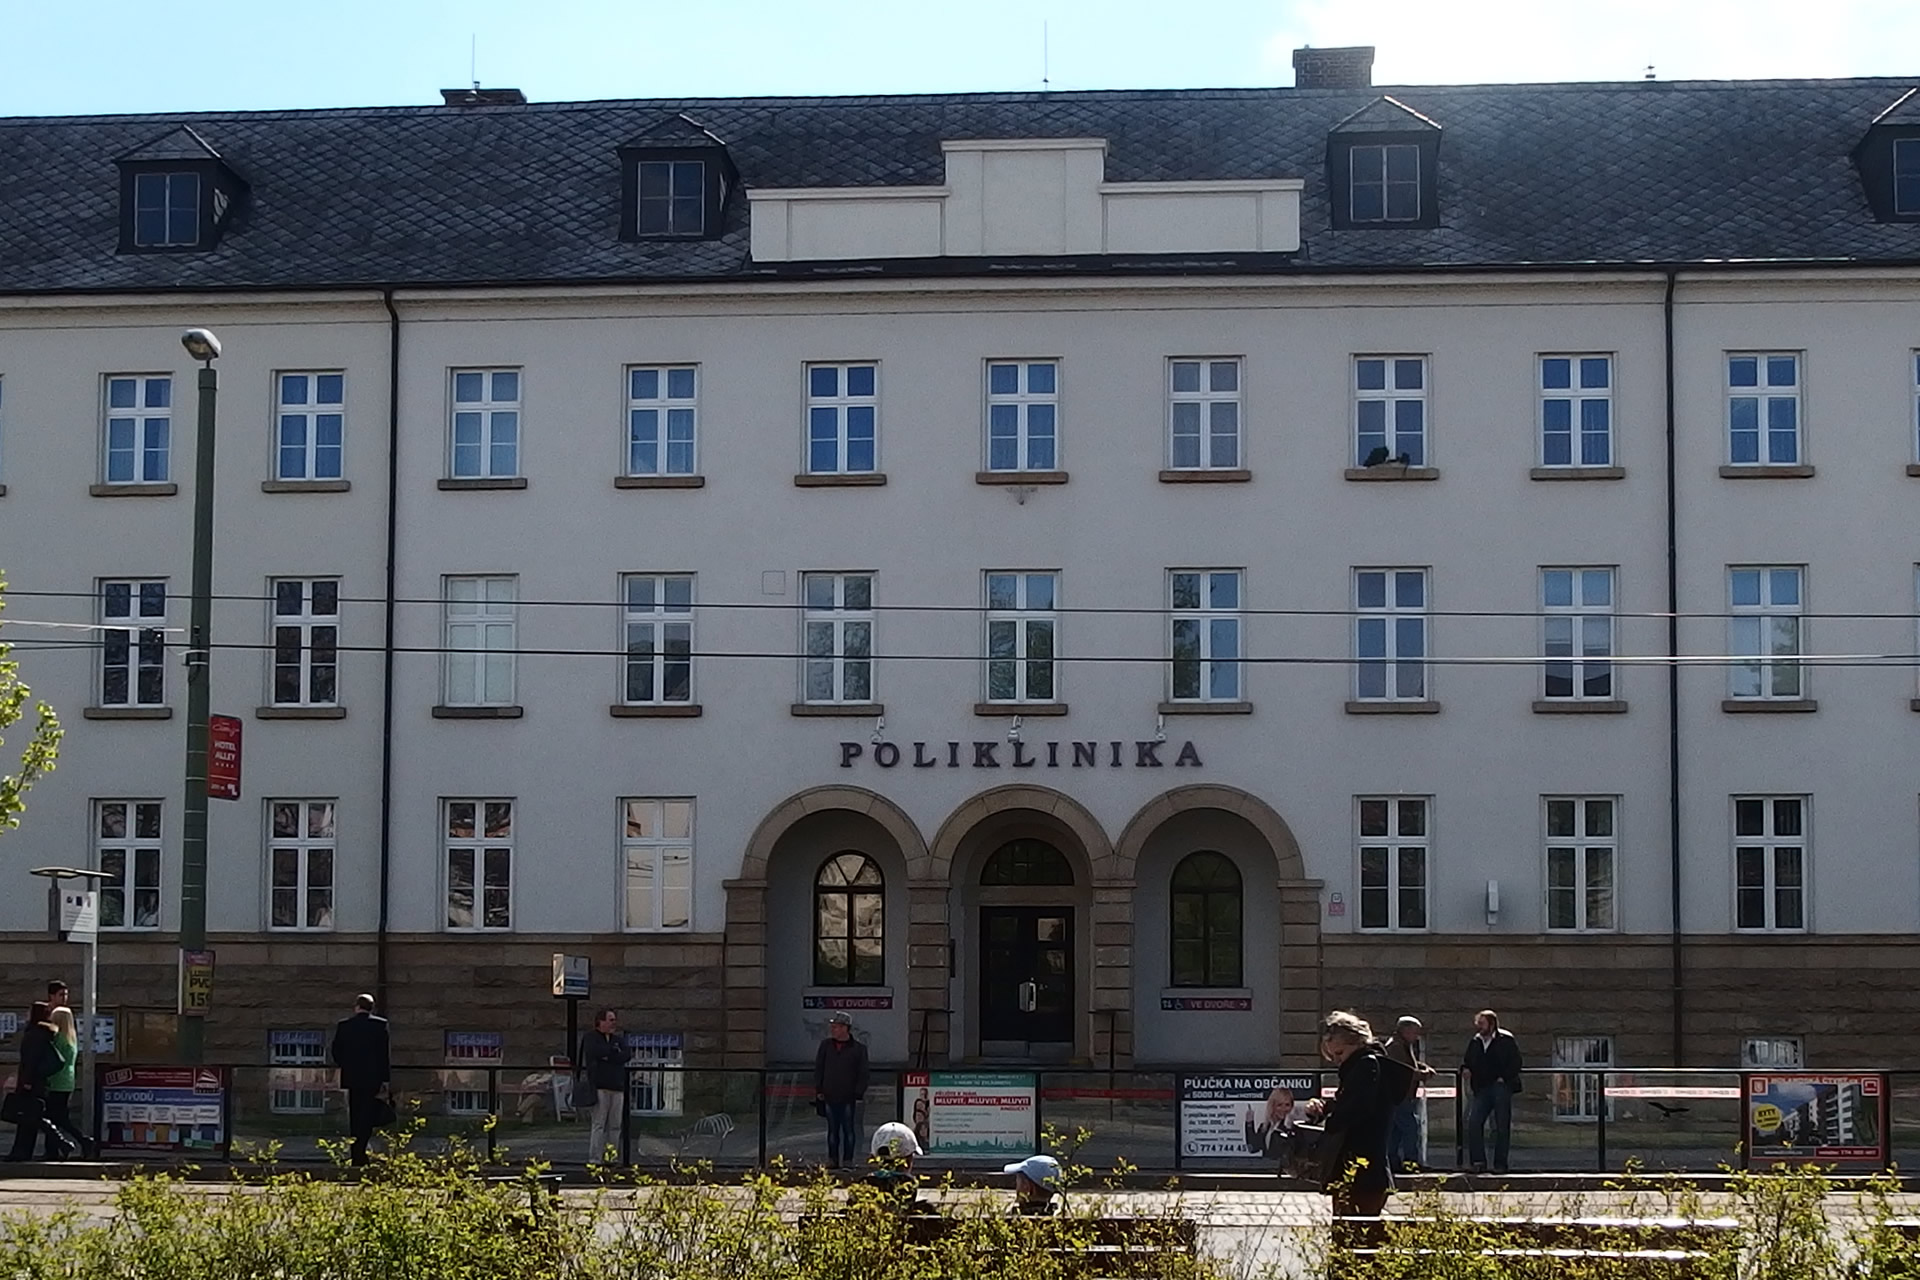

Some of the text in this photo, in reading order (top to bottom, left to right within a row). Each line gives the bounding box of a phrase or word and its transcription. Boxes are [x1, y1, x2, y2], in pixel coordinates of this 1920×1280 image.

[840, 741, 1203, 768] POLIKLINIKA
[832, 999, 843, 1008] VE
[1191, 1000, 1202, 1009] VE
[1184, 1076, 1312, 1089] PŮJČKA NA OBČANKU
[113, 1090, 154, 1101] DŮVODŮ
[936, 1097, 1029, 1105] MLUVIT, MLUVIT, MLUVIT
